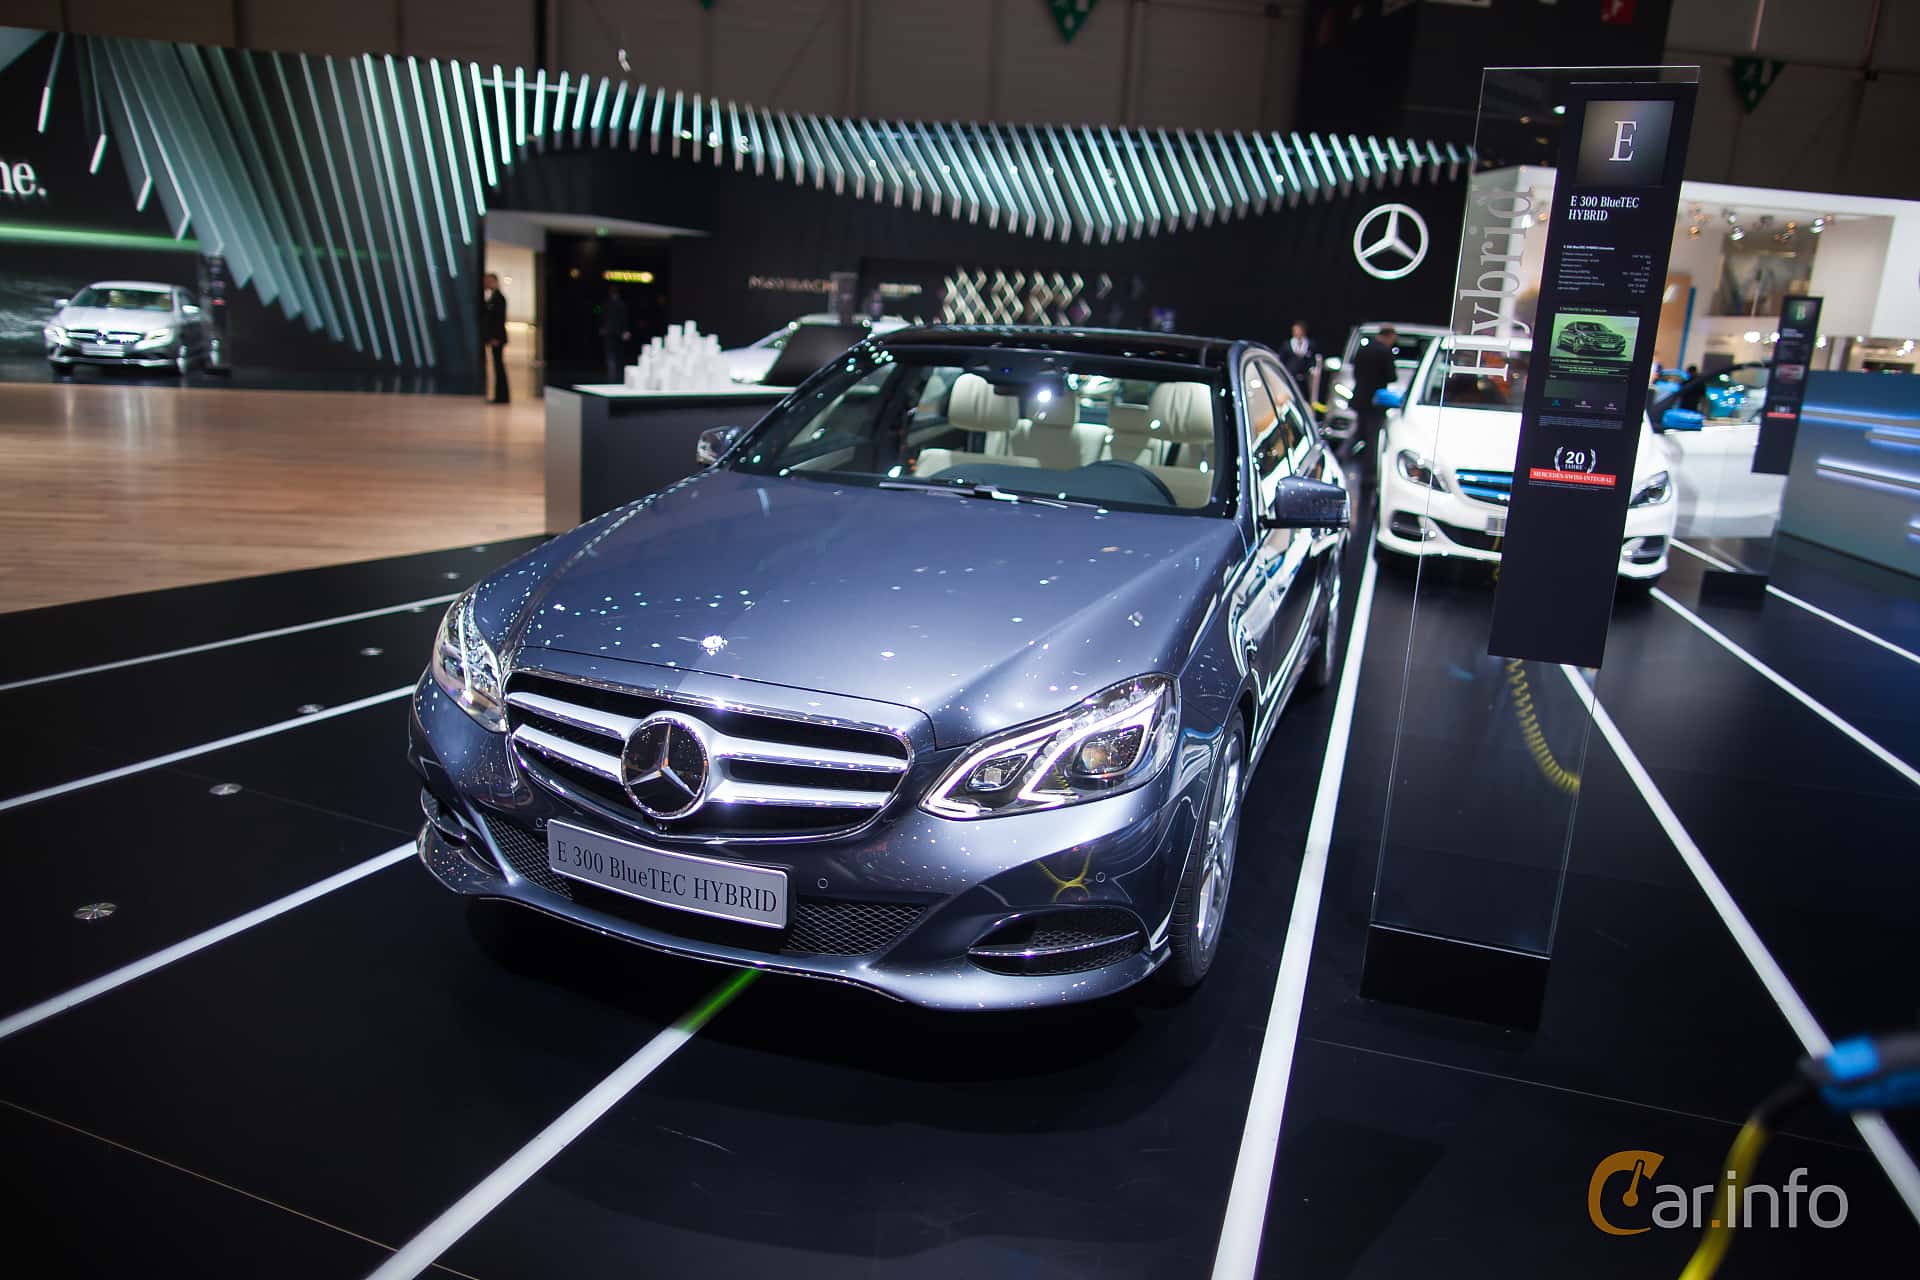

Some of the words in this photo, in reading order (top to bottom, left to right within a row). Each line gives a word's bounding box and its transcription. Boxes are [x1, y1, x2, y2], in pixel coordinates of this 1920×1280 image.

[1608, 120, 1637, 162] E
[1568, 209, 1608, 222] HYBRID
[1570, 195, 1577, 207] E
[1580, 196, 1598, 208] 300
[1600, 196, 1640, 209] BlueTEC
[1448, 186, 1535, 382] Hybrid
[1565, 451, 1585, 465] 20
[557, 840, 568, 863] E
[573, 846, 603, 873] 300
[609, 854, 687, 896] BlueTEC
[693, 876, 778, 913] HYBRID
